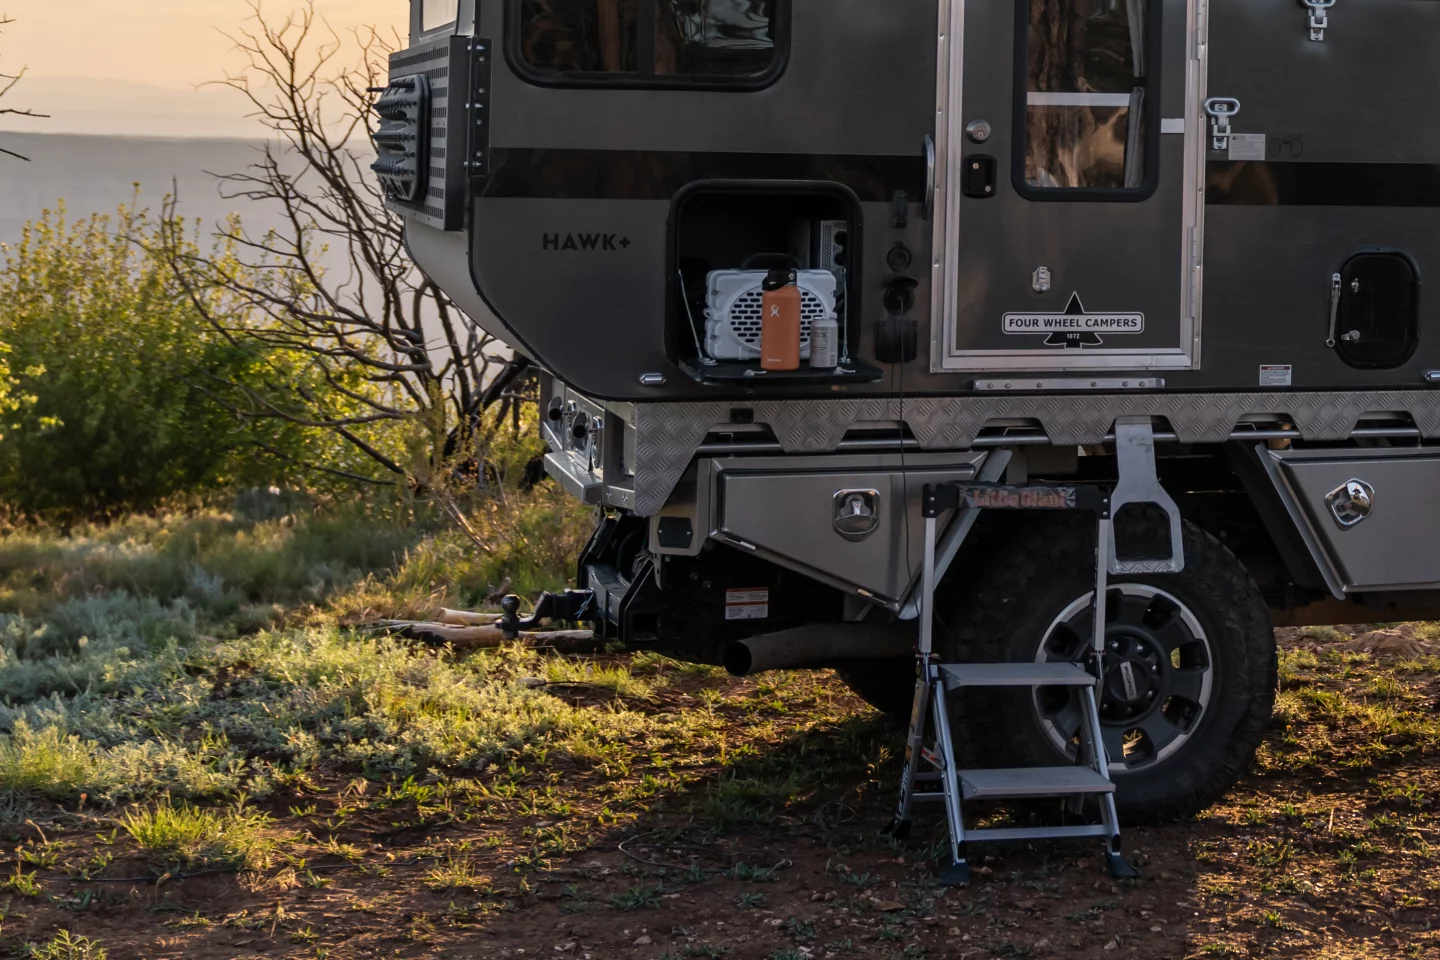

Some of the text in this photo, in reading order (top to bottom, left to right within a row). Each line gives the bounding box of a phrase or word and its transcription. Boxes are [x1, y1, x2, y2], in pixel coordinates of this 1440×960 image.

[542, 233, 631, 251] HAWK+
[1009, 318, 1138, 328] FOUR WHEEL CAMPERS
